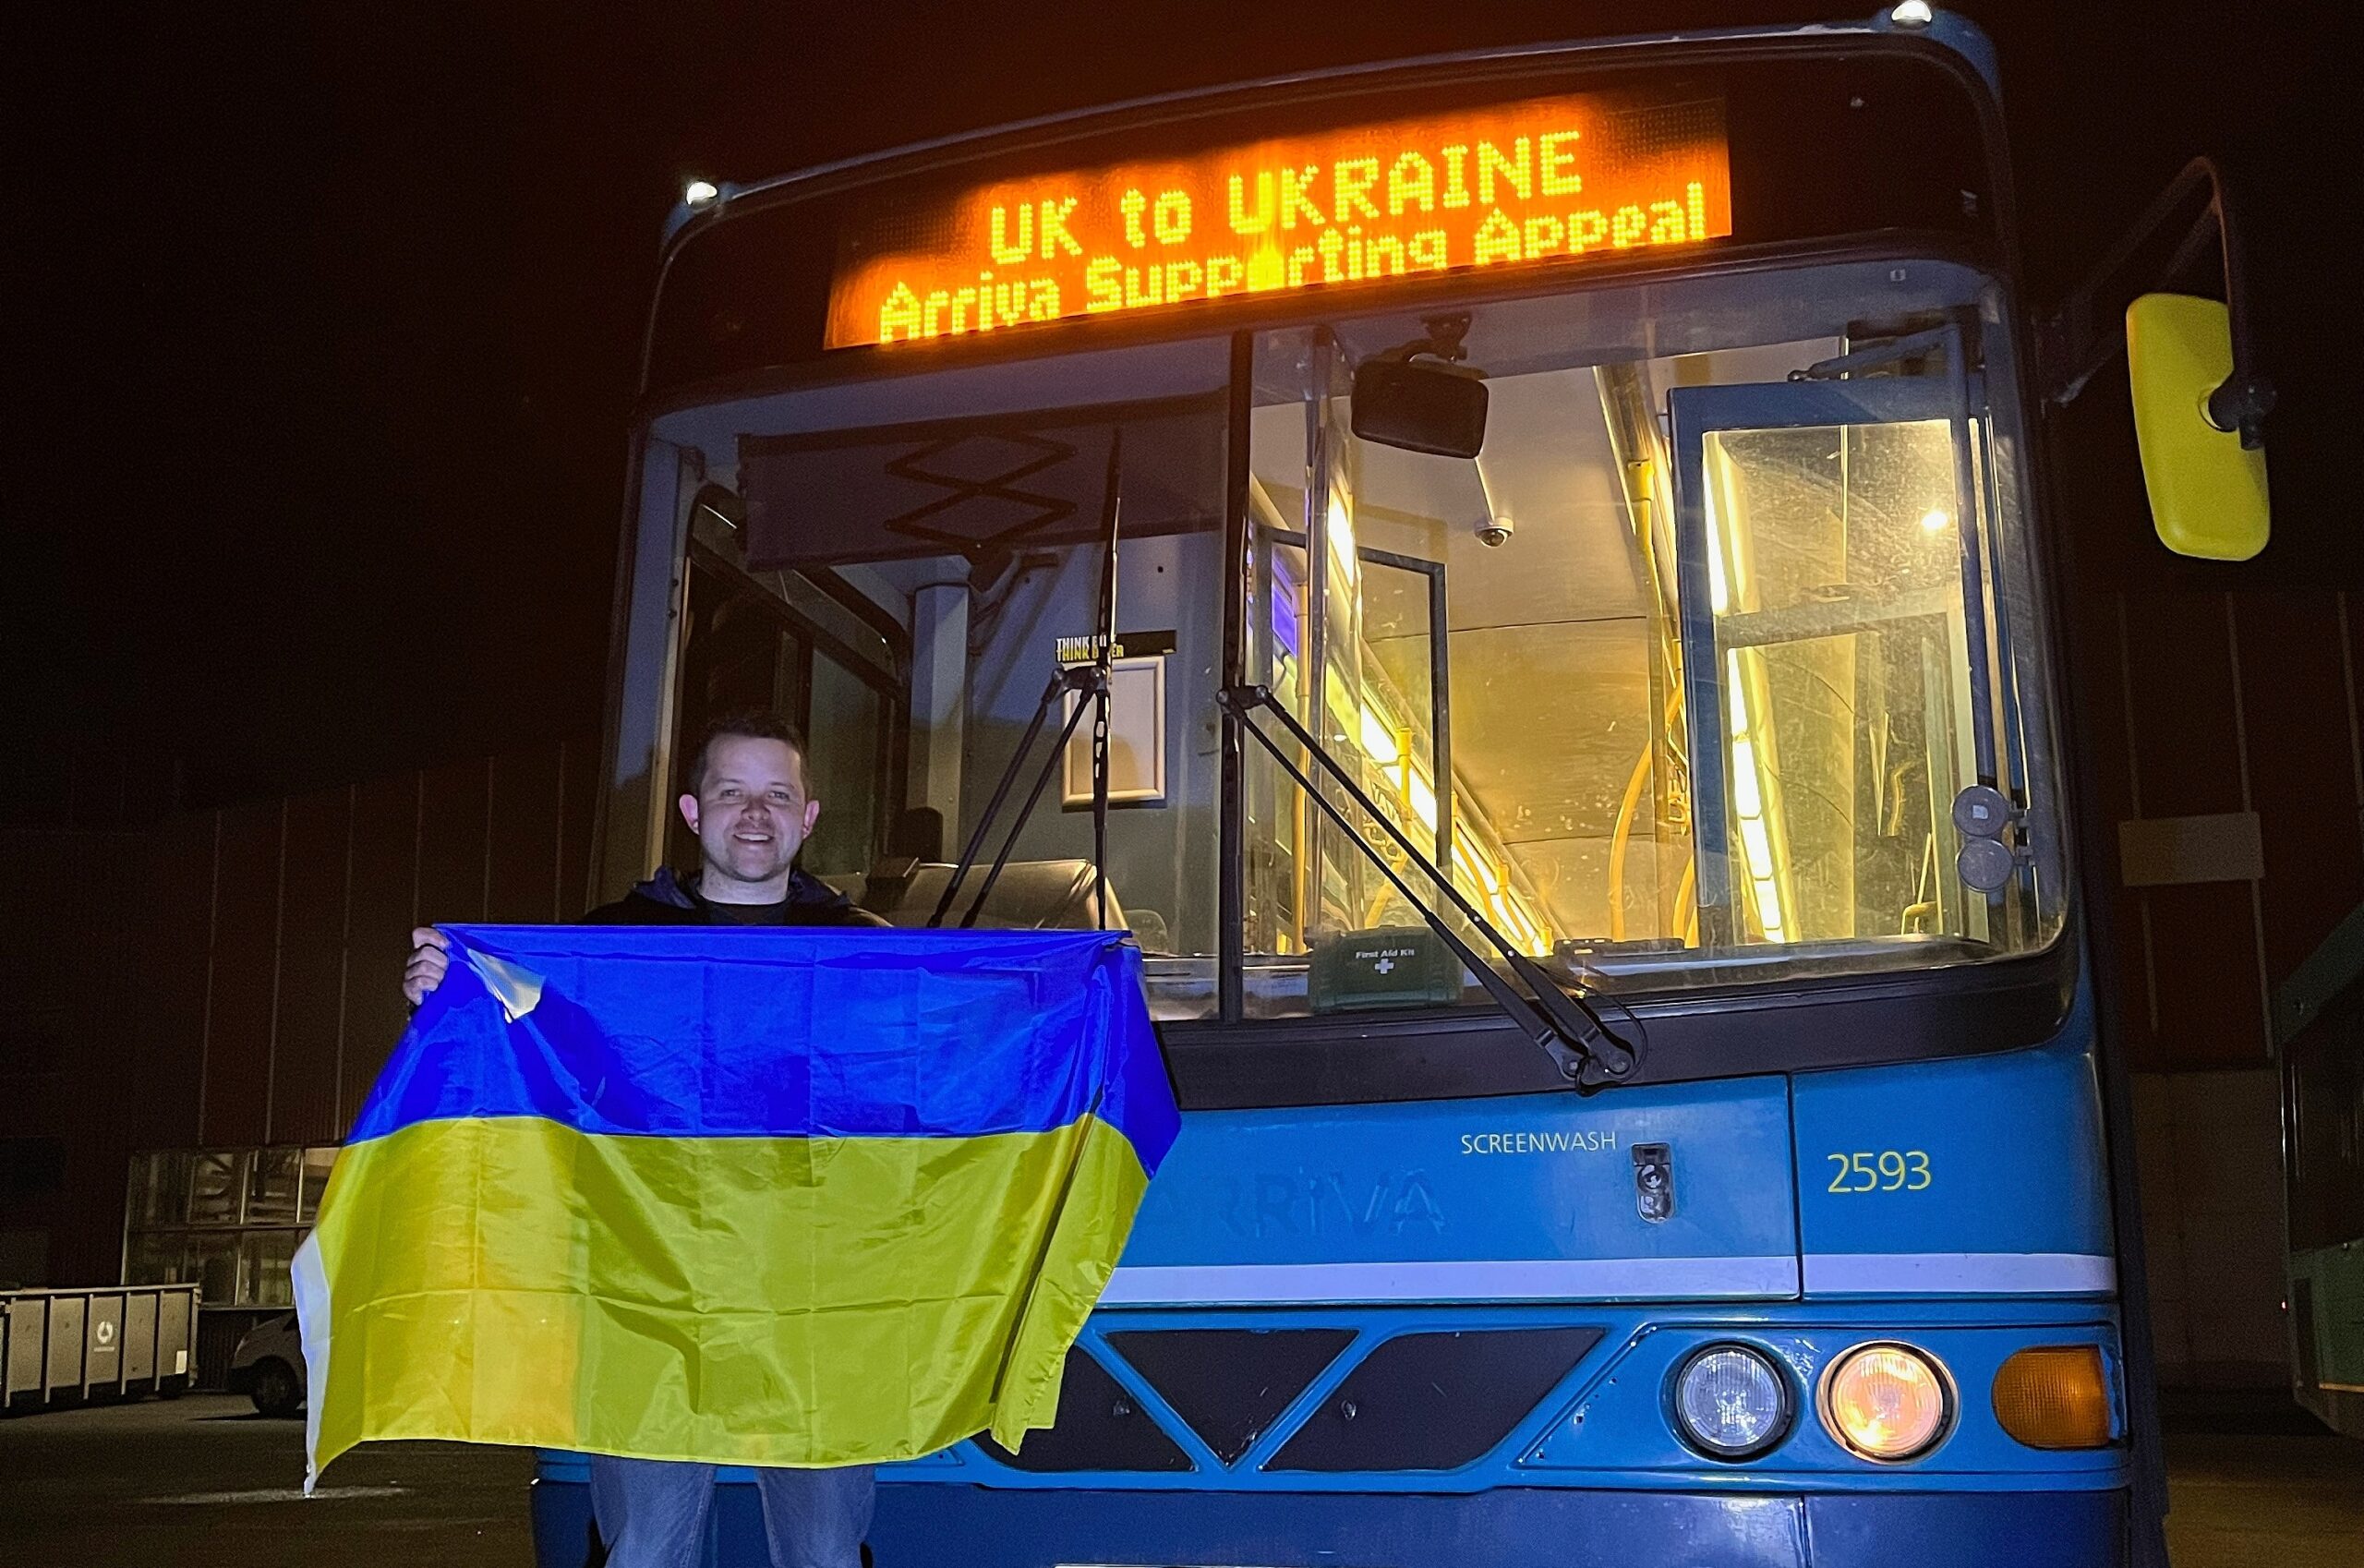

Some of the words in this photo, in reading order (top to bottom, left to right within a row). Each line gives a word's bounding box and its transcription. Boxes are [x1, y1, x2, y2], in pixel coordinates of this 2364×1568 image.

[991, 196, 1083, 264] UK
[1120, 187, 1192, 247] to
[1228, 130, 1581, 234] UKRAINE
[880, 271, 1060, 344] Arriva
[1474, 182, 1706, 265] Appeal
[1356, 949, 1379, 959] First
[1381, 948, 1398, 958] Aid
[1400, 948, 1415, 957] Kit
[1461, 1131, 1616, 1154] SCREENWASH
[1827, 1151, 1932, 1192] 2593
